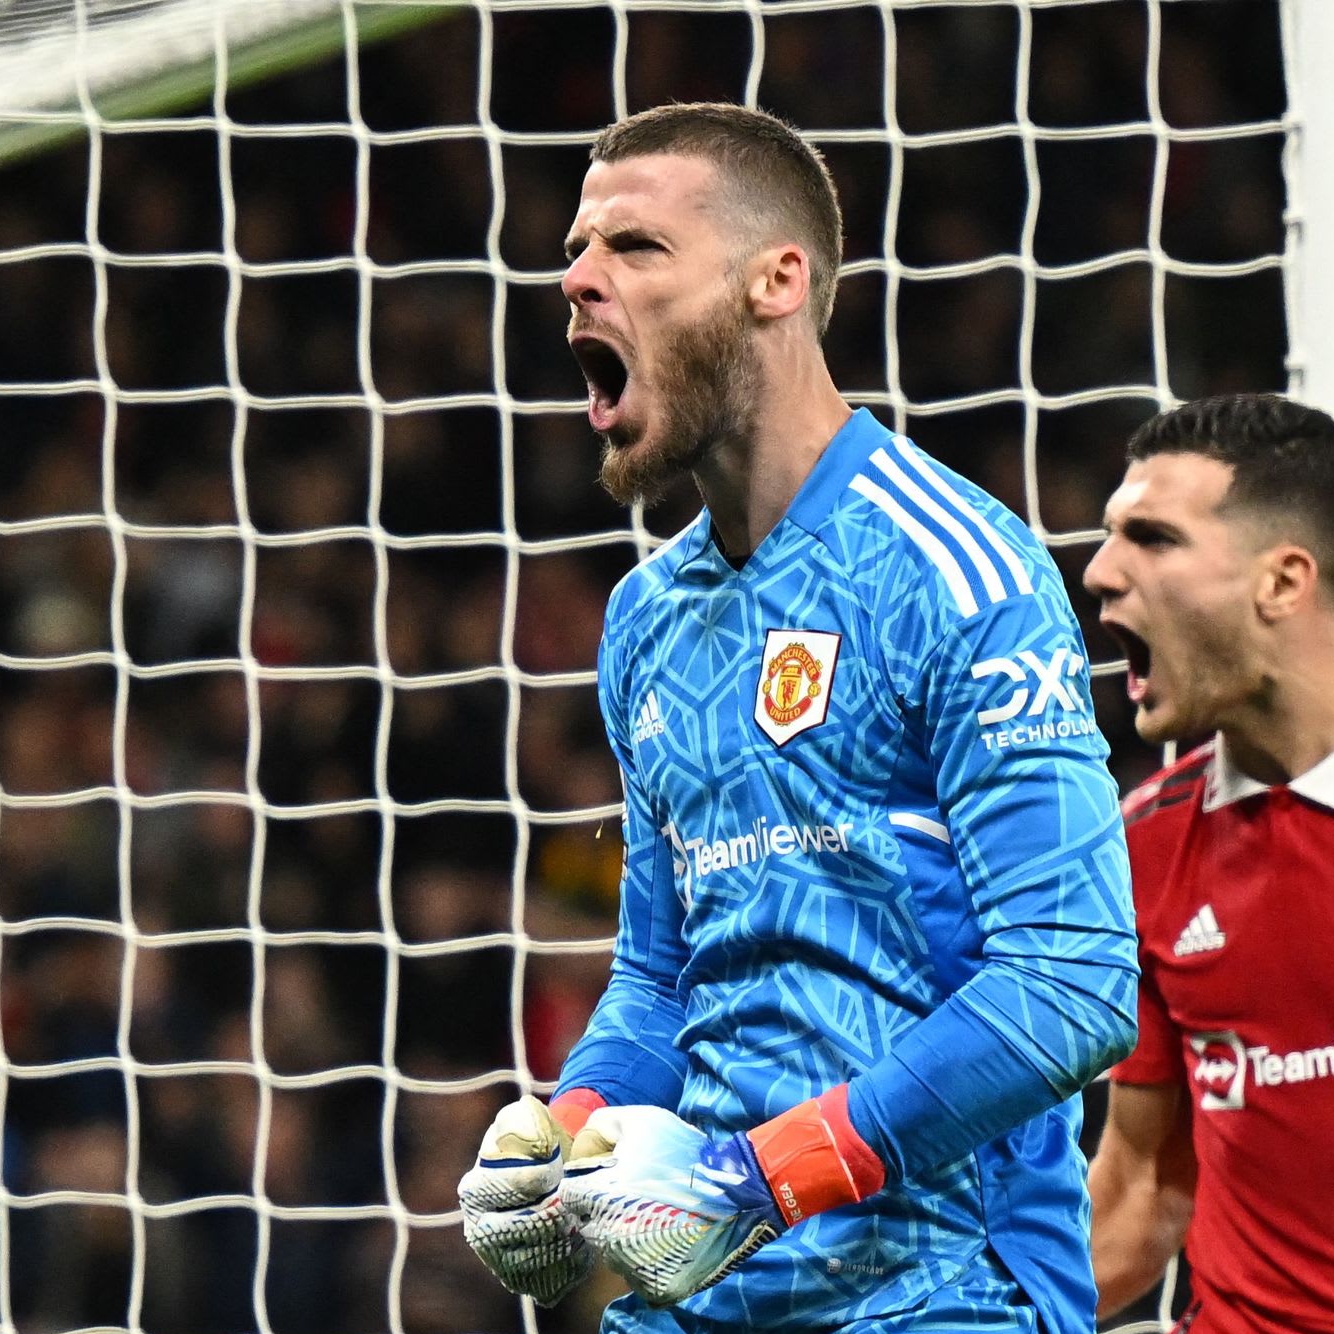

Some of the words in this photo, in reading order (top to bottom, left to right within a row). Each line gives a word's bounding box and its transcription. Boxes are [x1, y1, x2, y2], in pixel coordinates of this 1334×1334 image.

[771, 648, 817, 677] MANCHESTER
[769, 707, 801, 721] UNITED
[686, 816, 854, 878] TeamViewer
[779, 1181, 797, 1208] GEA
